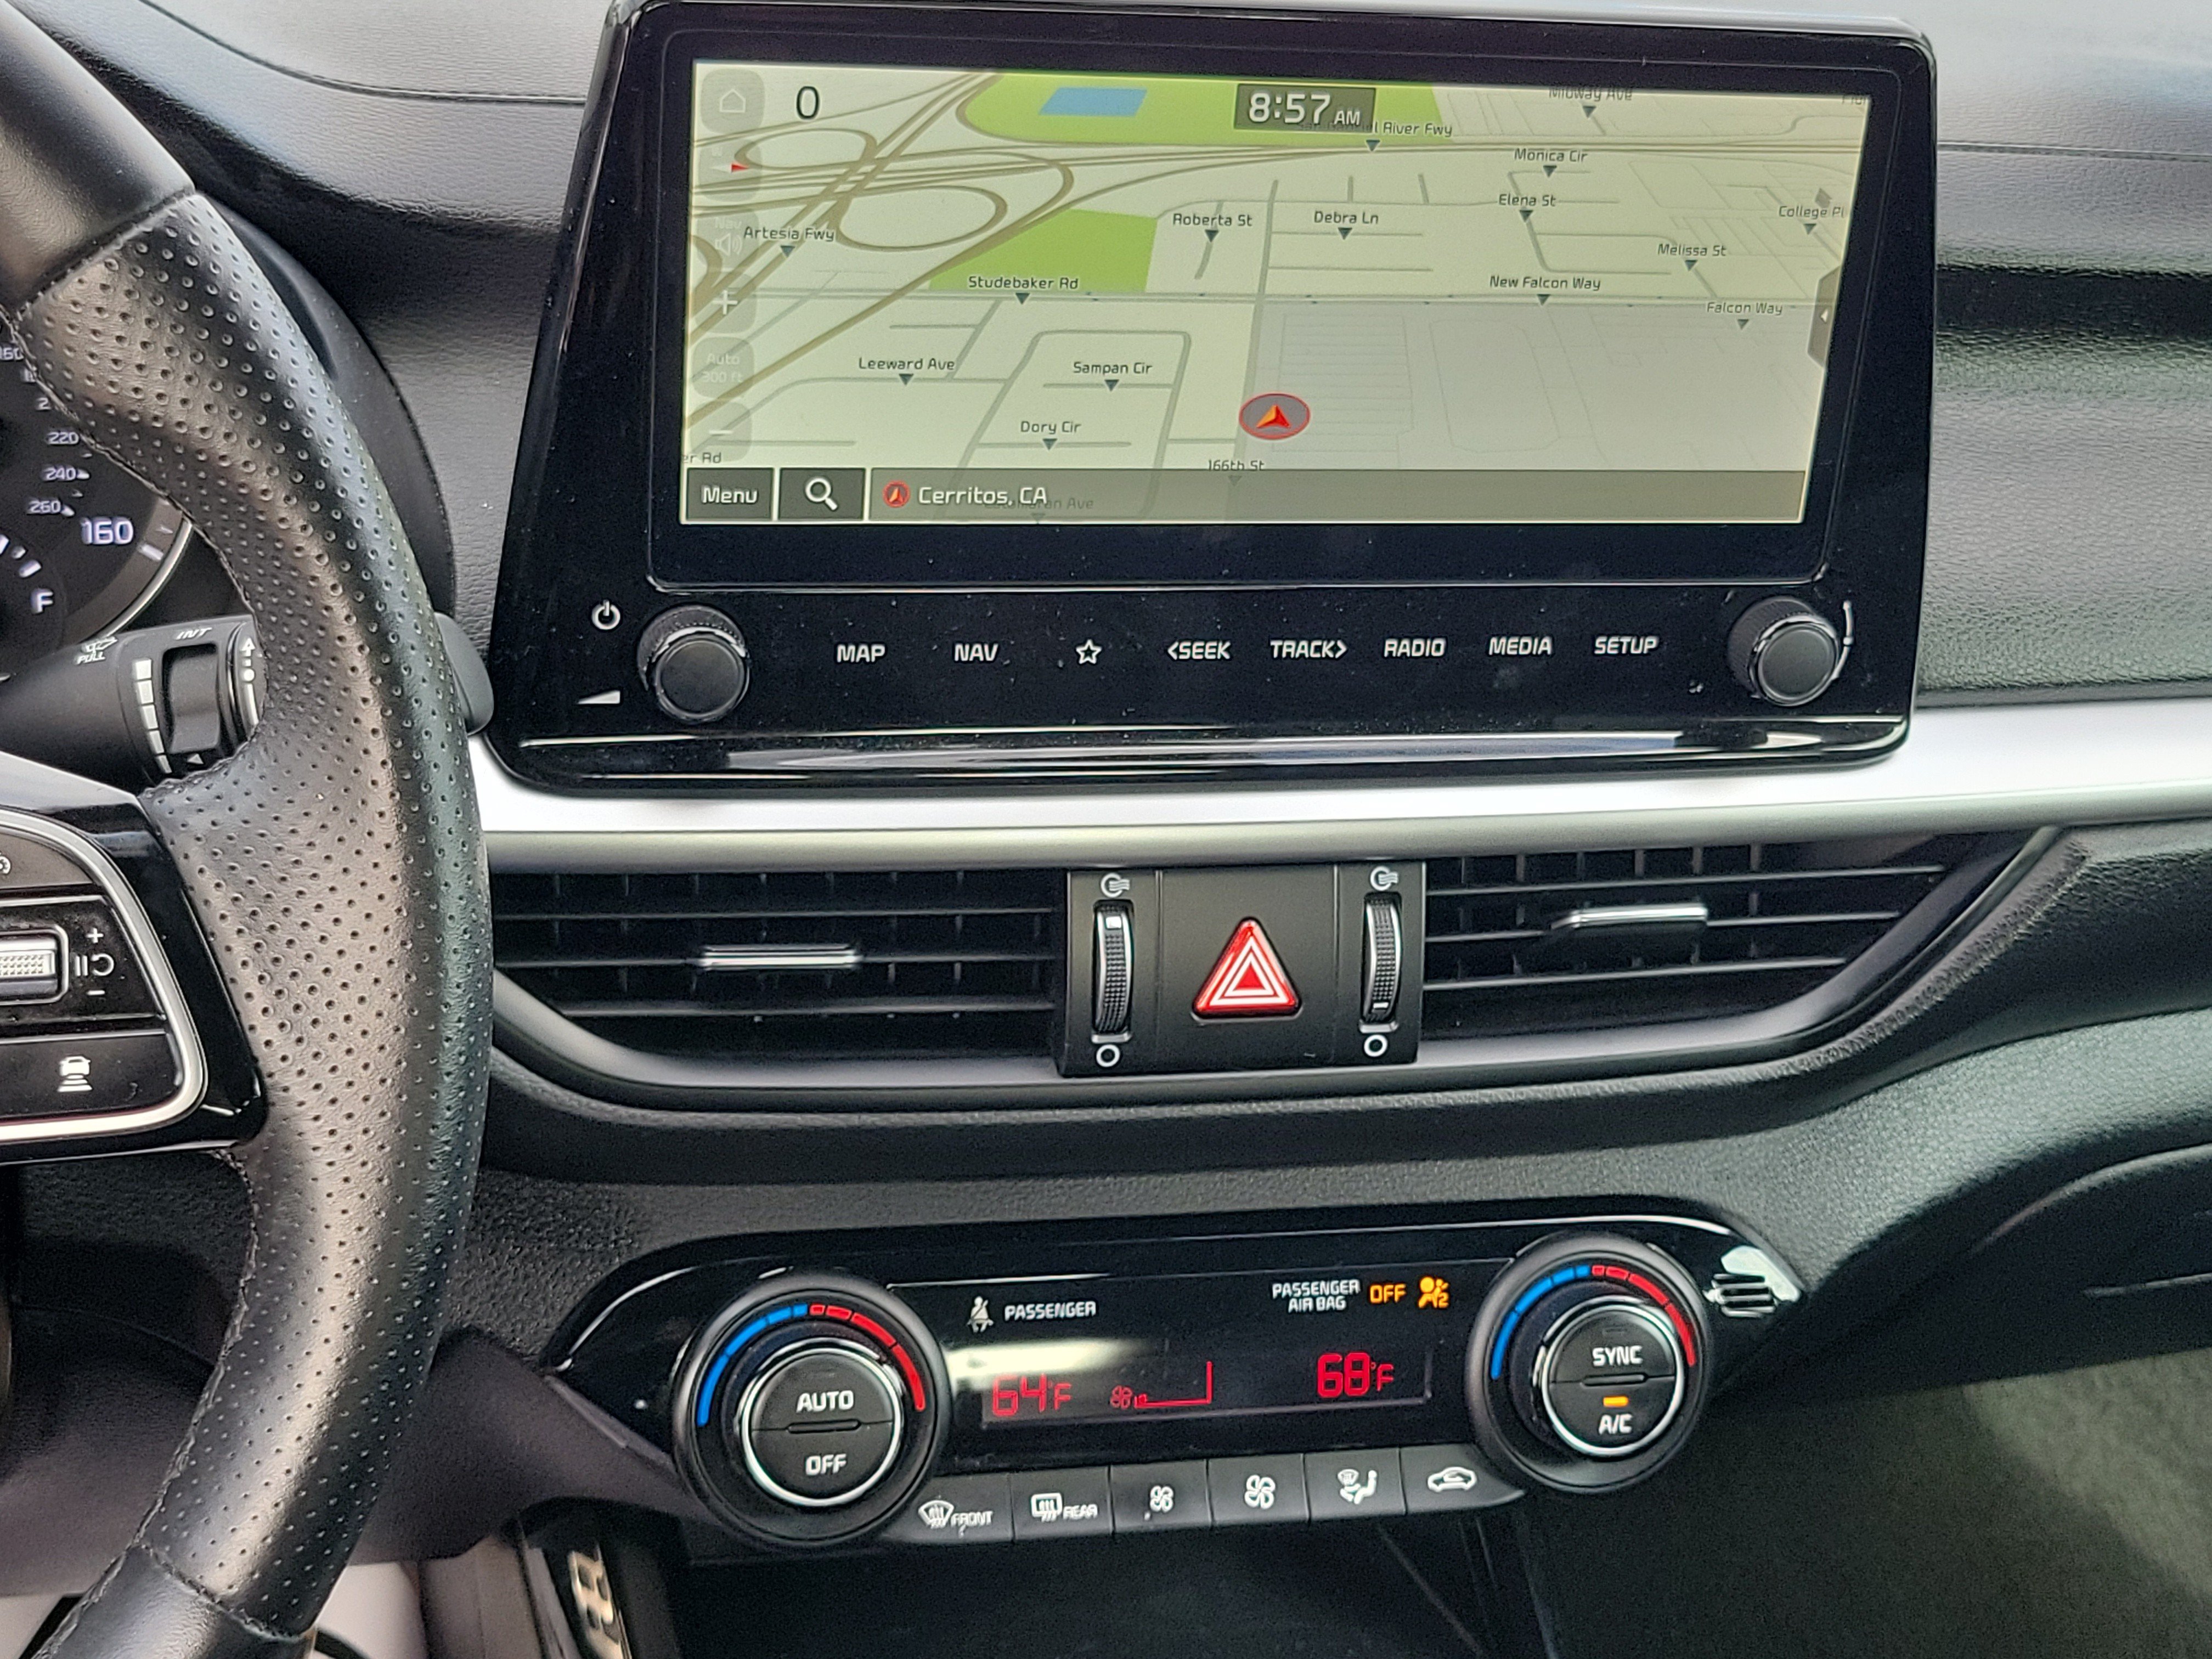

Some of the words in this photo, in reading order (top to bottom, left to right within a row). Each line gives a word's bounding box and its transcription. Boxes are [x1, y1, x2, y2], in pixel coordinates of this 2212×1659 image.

[1249, 92, 1331, 123] 8:57
[1334, 109, 1361, 126] AM
[1384, 122, 1420, 134] River
[1425, 122, 1453, 137] Fwy
[1514, 149, 1565, 162] Monica
[1570, 149, 1588, 161] Cir
[1498, 194, 1536, 206] Elena
[1541, 194, 1556, 207] St
[1173, 213, 1232, 226] Roberta
[1238, 213, 1252, 227] St
[1314, 211, 1357, 224] Debra
[1362, 212, 1379, 224] Ln
[1779, 205, 1827, 219] College
[743, 226, 799, 240] Artesia
[805, 228, 835, 242] Fwy
[1658, 244, 1707, 256] Melissa
[1712, 245, 1726, 256] St
[968, 275, 1053, 289] Studebaker
[1060, 276, 1078, 289] Rd
[1489, 275, 1518, 289] New
[1522, 276, 1568, 290] Falcon
[1573, 276, 1601, 291] Way
[1707, 302, 1751, 314] Falcon
[1756, 302, 1782, 316] Way
[859, 357, 923, 370] Leeward
[927, 358, 955, 370] Ave
[1073, 362, 1129, 376] Sampan
[1133, 362, 1152, 374] Cir
[1020, 421, 1057, 435] Dory
[1061, 421, 1081, 433] Cir
[47, 431, 80, 444] 220
[703, 452, 722, 464] Rd
[1250, 460, 1265, 471] St
[43, 467, 76, 481] 240
[702, 485, 758, 504] Menu
[918, 487, 1013, 506] Cerritos,
[1019, 487, 1048, 504] CA
[28, 500, 61, 514] 260
[1066, 497, 1094, 509] Ave
[81, 517, 134, 545] 160
[32, 588, 53, 614] F
[175, 627, 212, 640] INT
[954, 643, 998, 662] NAV
[1384, 638, 1446, 657] RADIO
[1488, 636, 1553, 655] MEDIA
[1594, 636, 1659, 654] SETUP
[75, 651, 105, 665] PULL
[837, 644, 886, 663] MAP
[1272, 1279, 1361, 1299] PASSENGER
[1370, 1284, 1407, 1304] OFF
[1004, 1300, 1097, 1321] PASSENGER
[1288, 1297, 1314, 1313] AIR
[1316, 1296, 1346, 1311] BAG
[1592, 1345, 1643, 1367] SYNC
[796, 1390, 854, 1413] AUTO
[1598, 1414, 1633, 1434] A/C
[805, 1453, 847, 1476] OFF
[951, 1511, 994, 1527] FRONT
[1063, 1504, 1098, 1520] REAR
